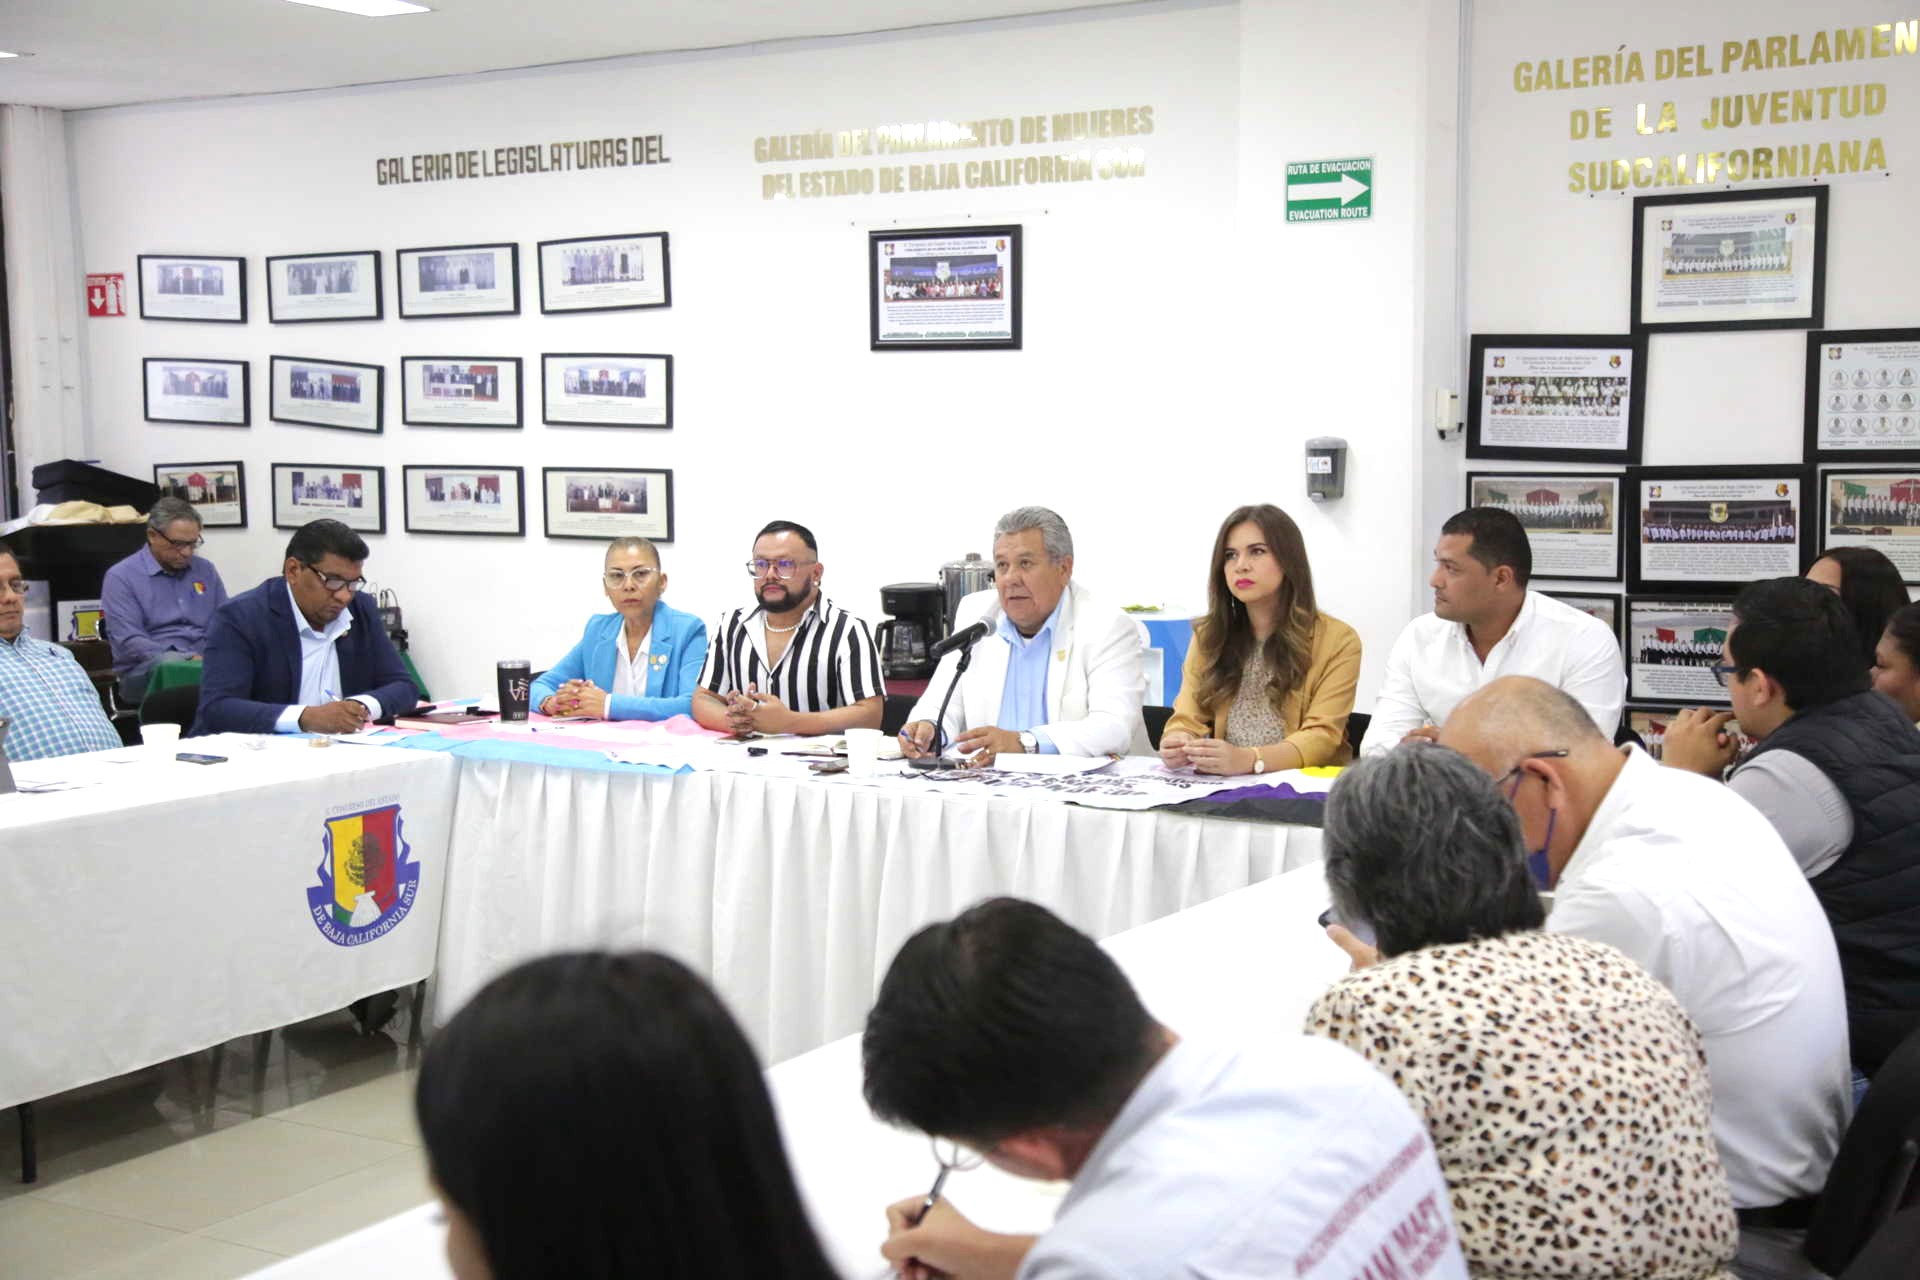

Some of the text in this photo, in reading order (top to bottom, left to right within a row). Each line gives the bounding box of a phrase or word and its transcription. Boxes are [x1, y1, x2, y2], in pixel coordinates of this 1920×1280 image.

[1513, 44, 1645, 93] GALERÍA
[1654, 44, 1713, 81] DEL
[839, 127, 873, 156] DEL
[1020, 115, 1047, 143] DE
[1052, 105, 1153, 142] MUJERES
[1569, 83, 1887, 140] DE LA JUVENTUD
[376, 135, 671, 186] GALERIA DE LEGISLATURAS DEL
[762, 172, 796, 200] DEL
[800, 167, 874, 198] ESTADO
[879, 166, 905, 194] DE
[909, 161, 960, 192] BAJA
[965, 151, 1092, 188] CALIFORNIA
[1287, 164, 1308, 176] RUTA
[1309, 163, 1320, 174] DE
[1568, 138, 1888, 194] SUDCALIFORNIANA
[1289, 207, 1368, 221] EVACUATION ROUTE
[313, 879, 417, 945] DE BAJA CALIFORNIA SUR
